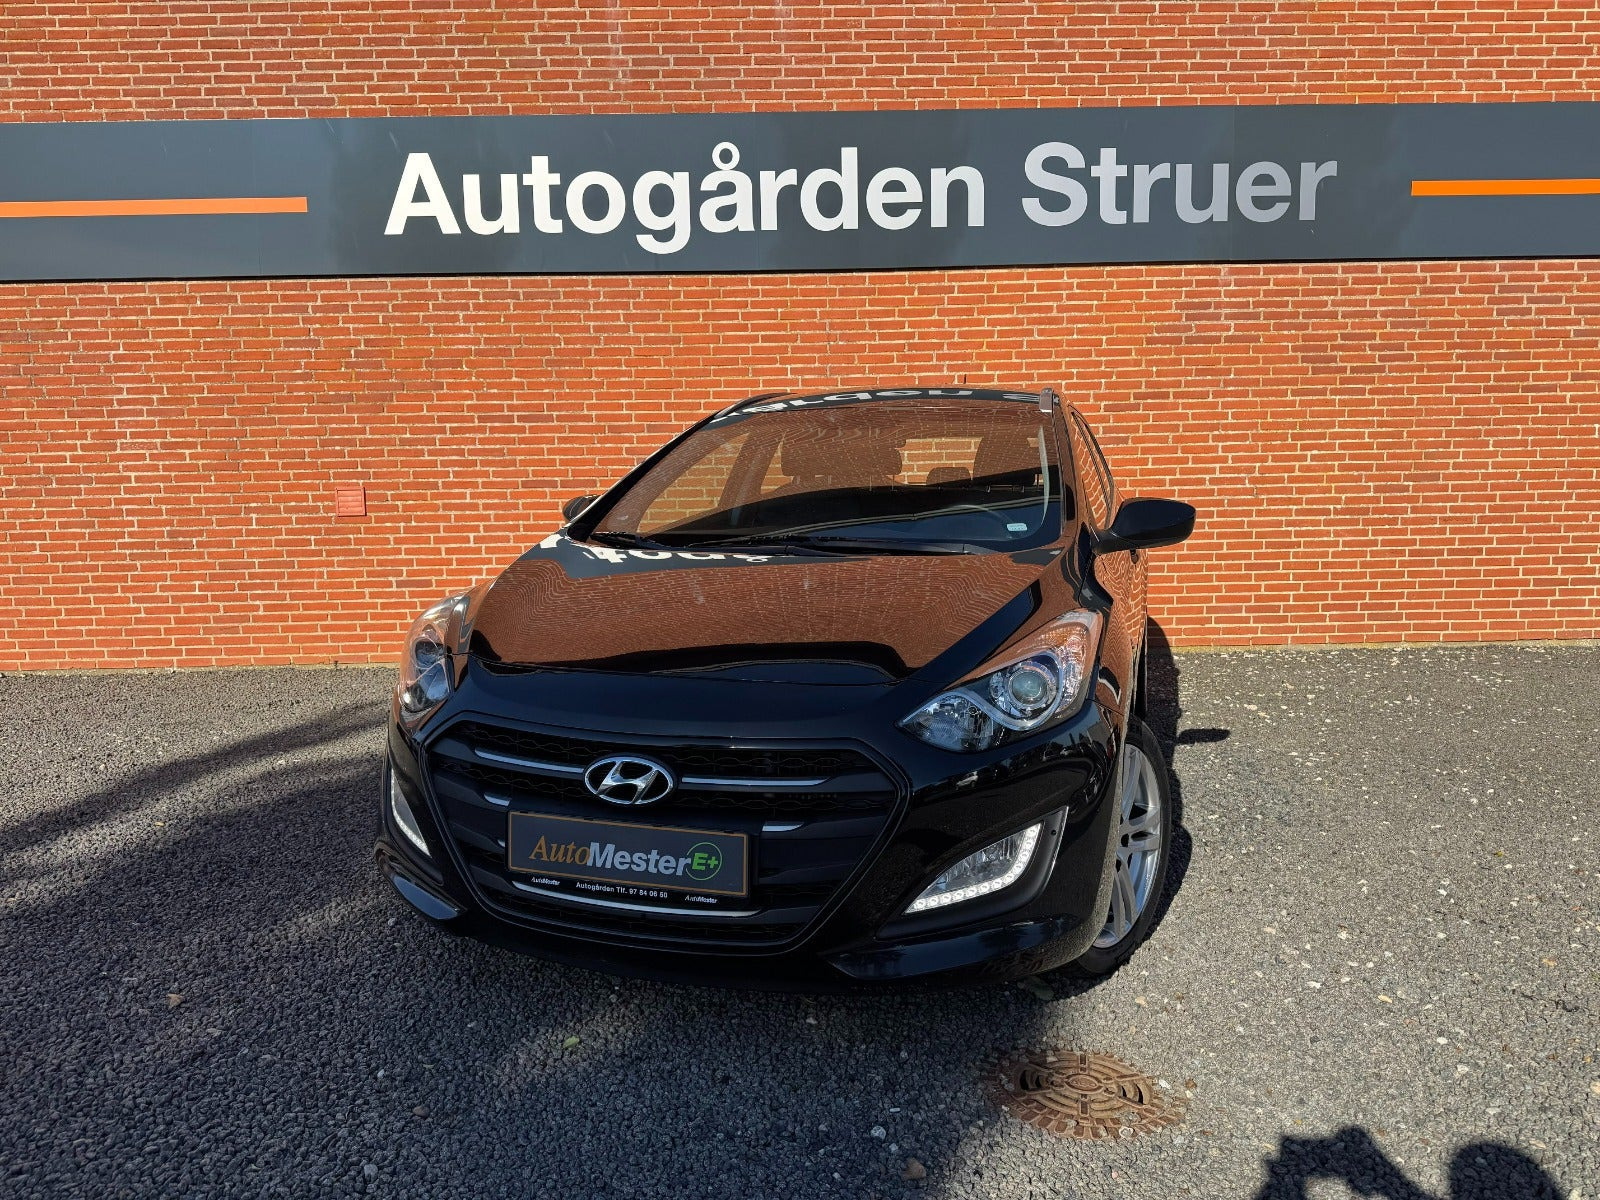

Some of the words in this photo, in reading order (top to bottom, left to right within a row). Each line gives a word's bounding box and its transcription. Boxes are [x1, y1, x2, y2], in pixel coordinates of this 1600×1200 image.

[384, 142, 985, 254] Autogården
[1021, 141, 1338, 227] Struer
[528, 835, 691, 876] AutoMester
[575, 881, 615, 892] Autogården
